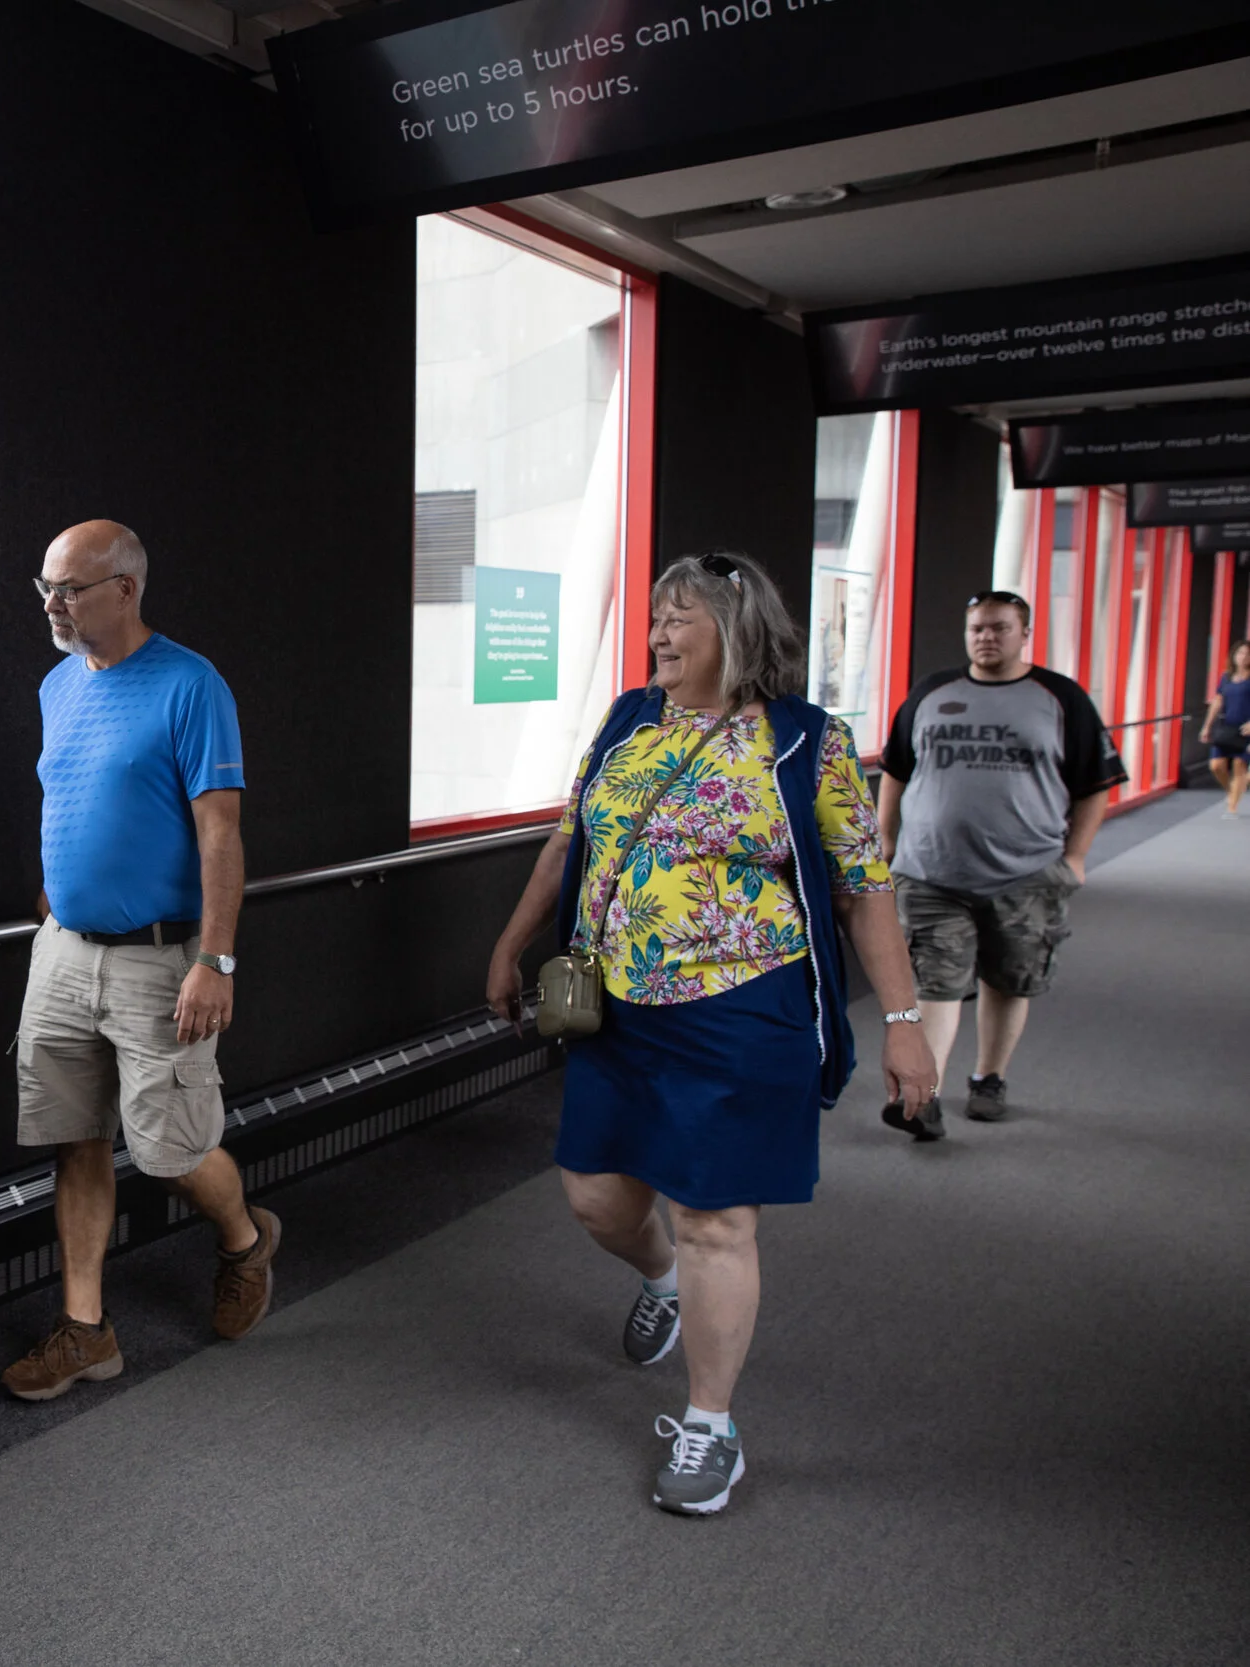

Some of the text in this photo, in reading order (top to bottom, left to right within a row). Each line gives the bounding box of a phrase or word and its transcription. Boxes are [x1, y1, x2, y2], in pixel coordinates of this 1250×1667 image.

[392, 0, 772, 104] Green sea turtles can hold
[399, 71, 639, 142] for up to 5 hours.
[878, 298, 1250, 355] Earth's longest mountain range stretch
[1042, 337, 1105, 357] twelve
[1111, 330, 1166, 349] times
[1171, 325, 1206, 343] the
